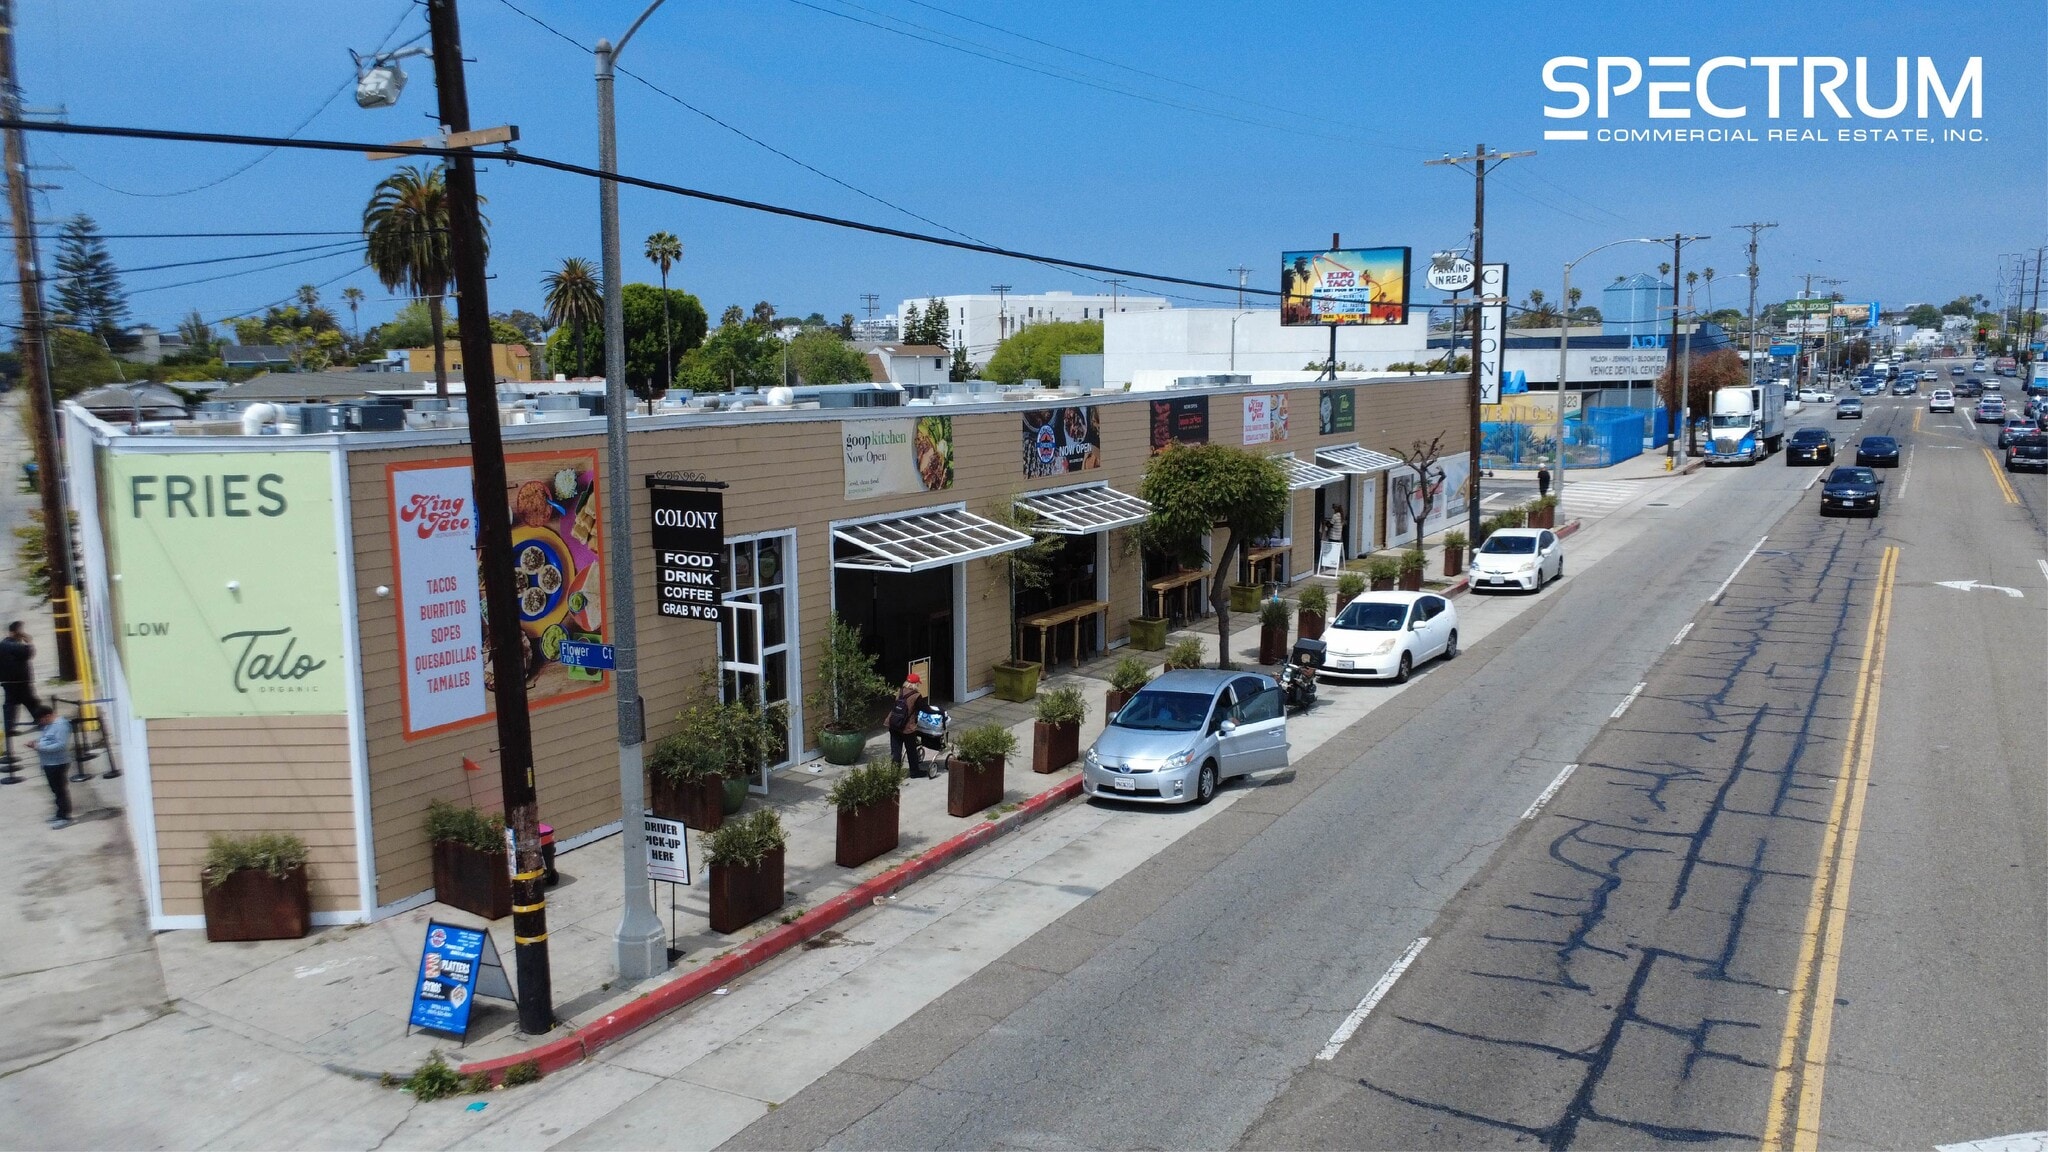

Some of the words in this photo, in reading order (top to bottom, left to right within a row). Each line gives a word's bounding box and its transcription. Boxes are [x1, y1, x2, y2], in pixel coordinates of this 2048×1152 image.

[1326, 279, 1355, 287] TACO
[1435, 276, 1444, 285] IN
[1445, 275, 1468, 284] REAR
[1590, 366, 1613, 375] VENICE
[1614, 366, 1638, 375] DENTAL
[1484, 405, 1554, 421] VENICE
[847, 452, 864, 464] Now
[866, 451, 887, 464] Open
[1060, 445, 1074, 456] NOW
[1076, 443, 1092, 454] OPEN
[131, 473, 288, 518] FRIES
[401, 494, 465, 522] King
[417, 512, 469, 539] Taco
[655, 508, 718, 530] COLONY
[664, 552, 714, 567] FOOD
[427, 576, 457, 594] TACOS
[664, 569, 714, 586] DRINK
[664, 586, 714, 602] COFFEE
[420, 599, 467, 620] BURRITOS
[662, 603, 689, 616] GRAB
[703, 607, 718, 619] GO
[431, 625, 461, 643] SOPES
[561, 642, 589, 657] Flower
[602, 646, 613, 659] Ct
[221, 627, 327, 693] Talo
[415, 645, 477, 675] QUESADILLAS
[562, 654, 575, 664] 700
[576, 656, 581, 664] E
[427, 671, 470, 693] TAMALES
[645, 821, 678, 835] DRIVER
[651, 849, 675, 862] HERE
[441, 959, 470, 975] PLATTERS
